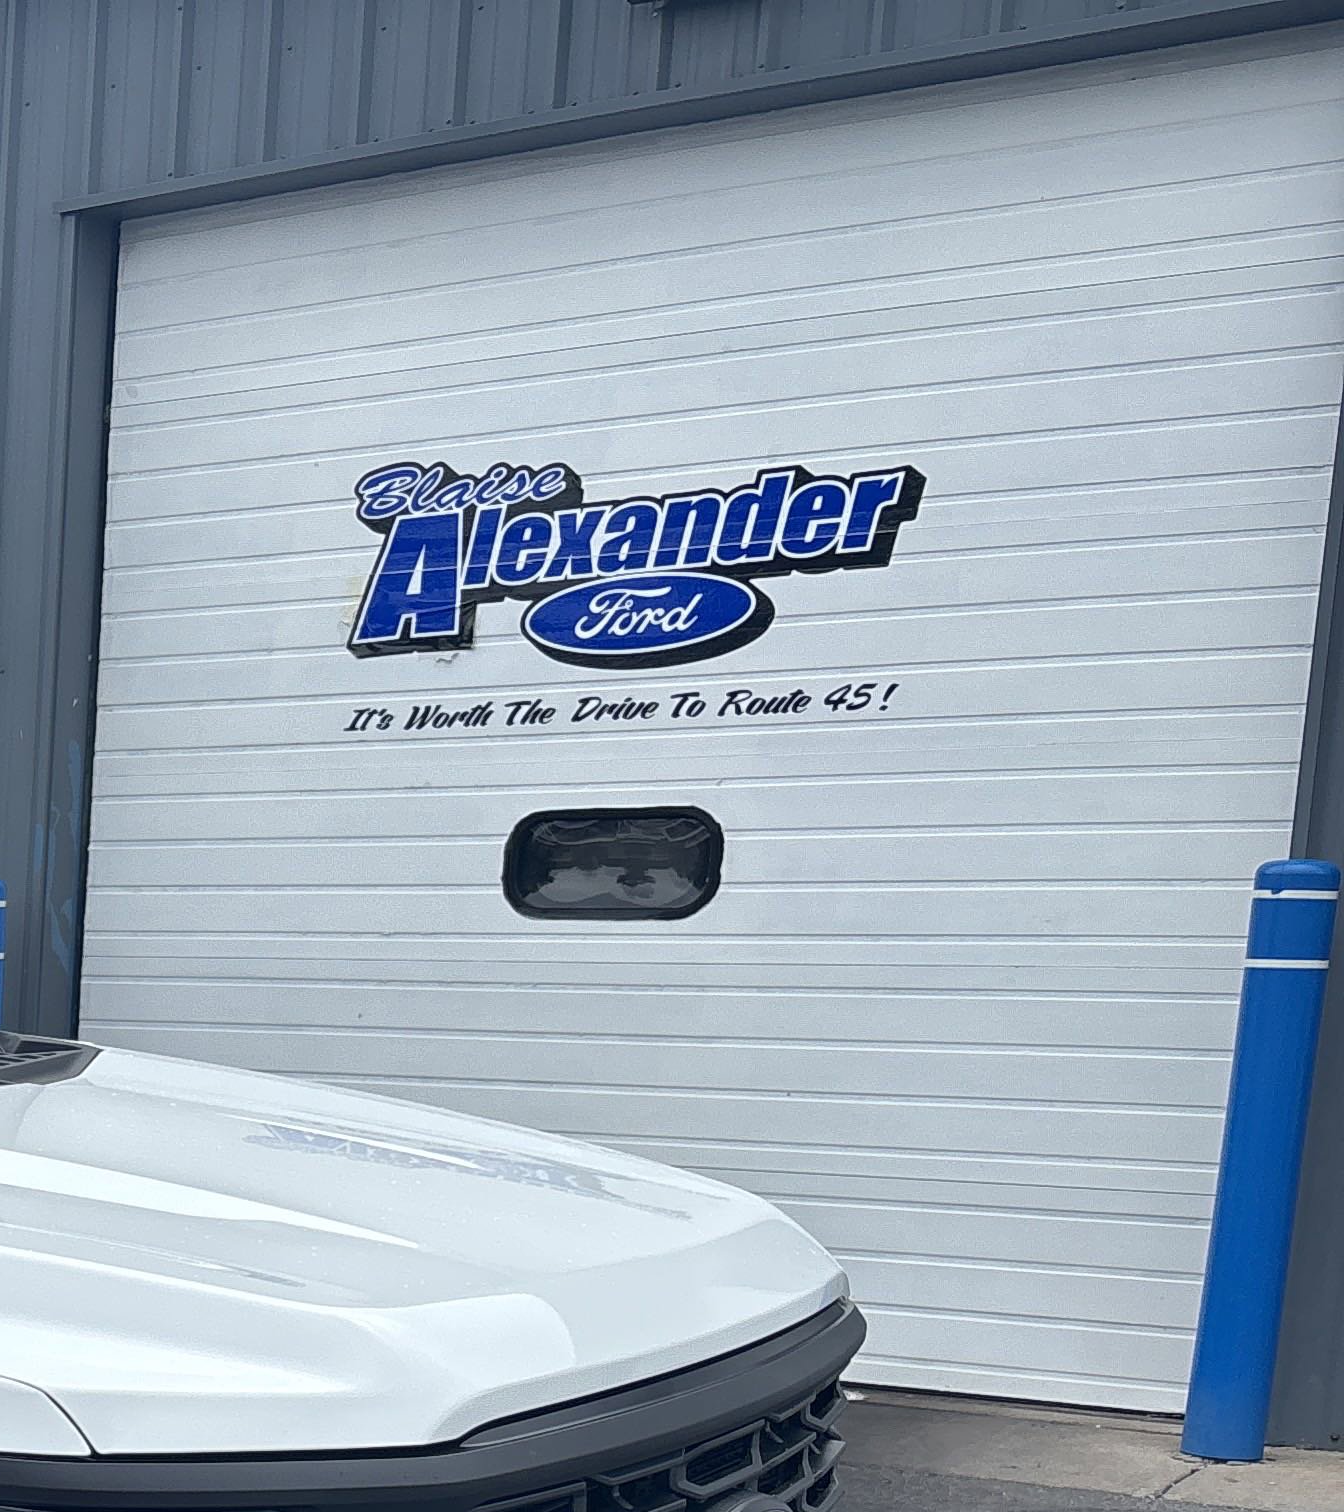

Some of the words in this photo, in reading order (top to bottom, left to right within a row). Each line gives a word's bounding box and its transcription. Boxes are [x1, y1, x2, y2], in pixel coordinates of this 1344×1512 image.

[359, 466, 566, 520] Blaise
[352, 469, 905, 644] Alexander
[574, 586, 703, 640] Ford
[344, 707, 395, 732] It's
[403, 700, 495, 731] Worth
[504, 698, 557, 727] The
[571, 695, 660, 722] Drive
[670, 691, 707, 719] To
[717, 688, 812, 717] Route
